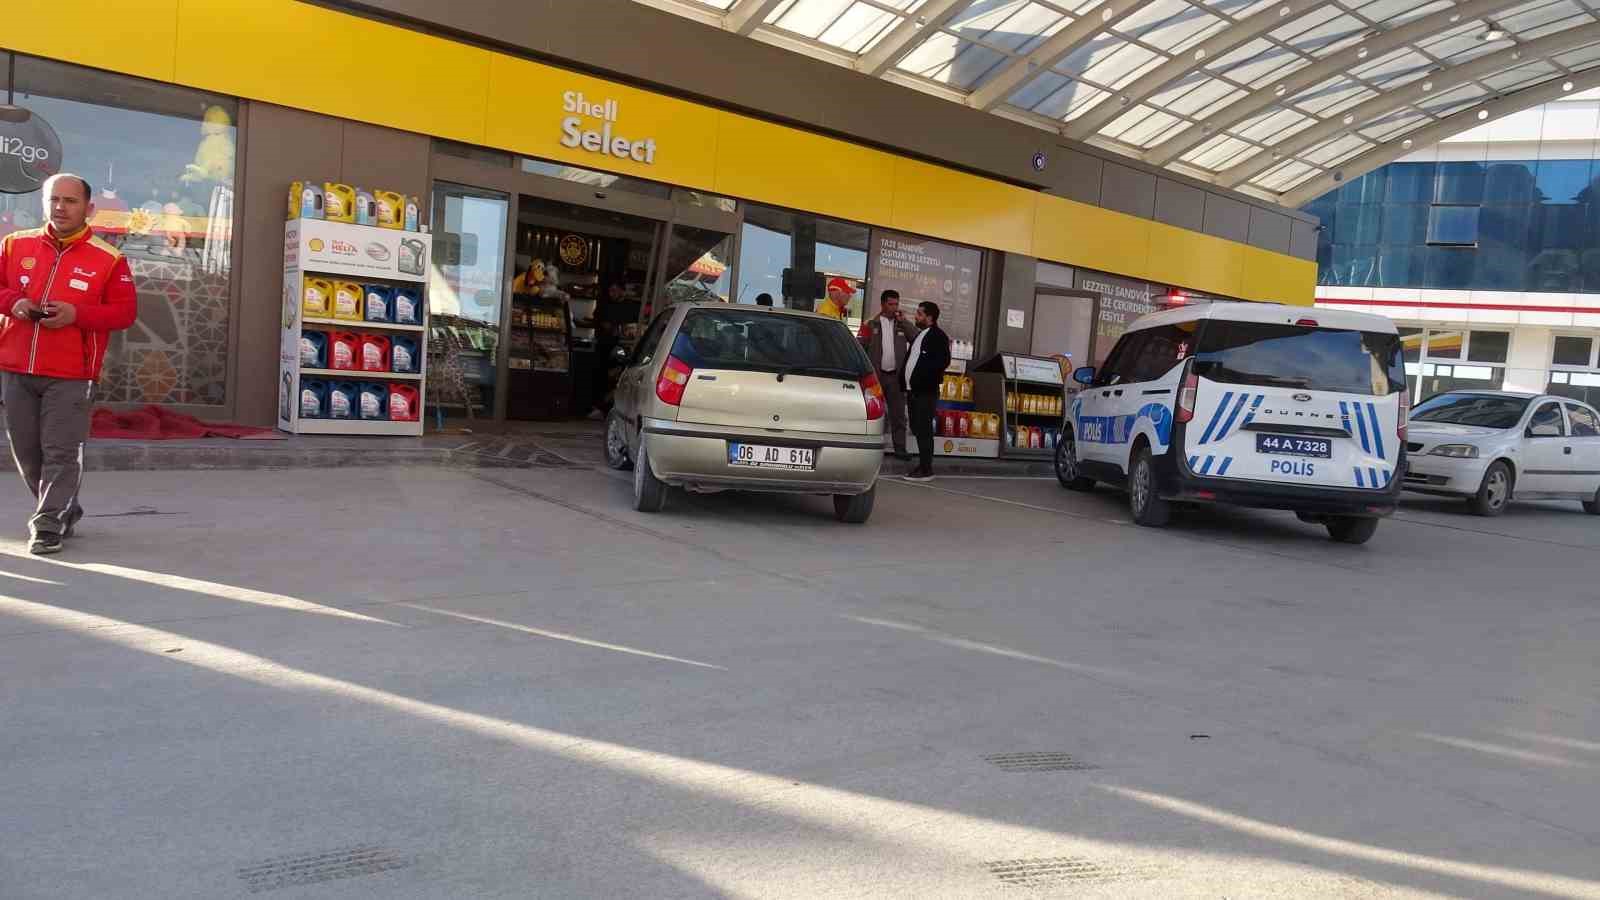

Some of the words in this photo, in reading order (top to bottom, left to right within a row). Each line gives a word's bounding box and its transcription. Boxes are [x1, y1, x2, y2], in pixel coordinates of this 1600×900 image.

[563, 90, 618, 122] Shell
[560, 116, 656, 164] Select
[739, 445, 754, 460] 06
[765, 447, 779, 462] AD
[790, 449, 812, 465] 614
[1263, 437, 1279, 448] 44
[1282, 439, 1293, 449] A
[1296, 440, 1327, 453] 7328
[1271, 458, 1314, 476] POLİS
